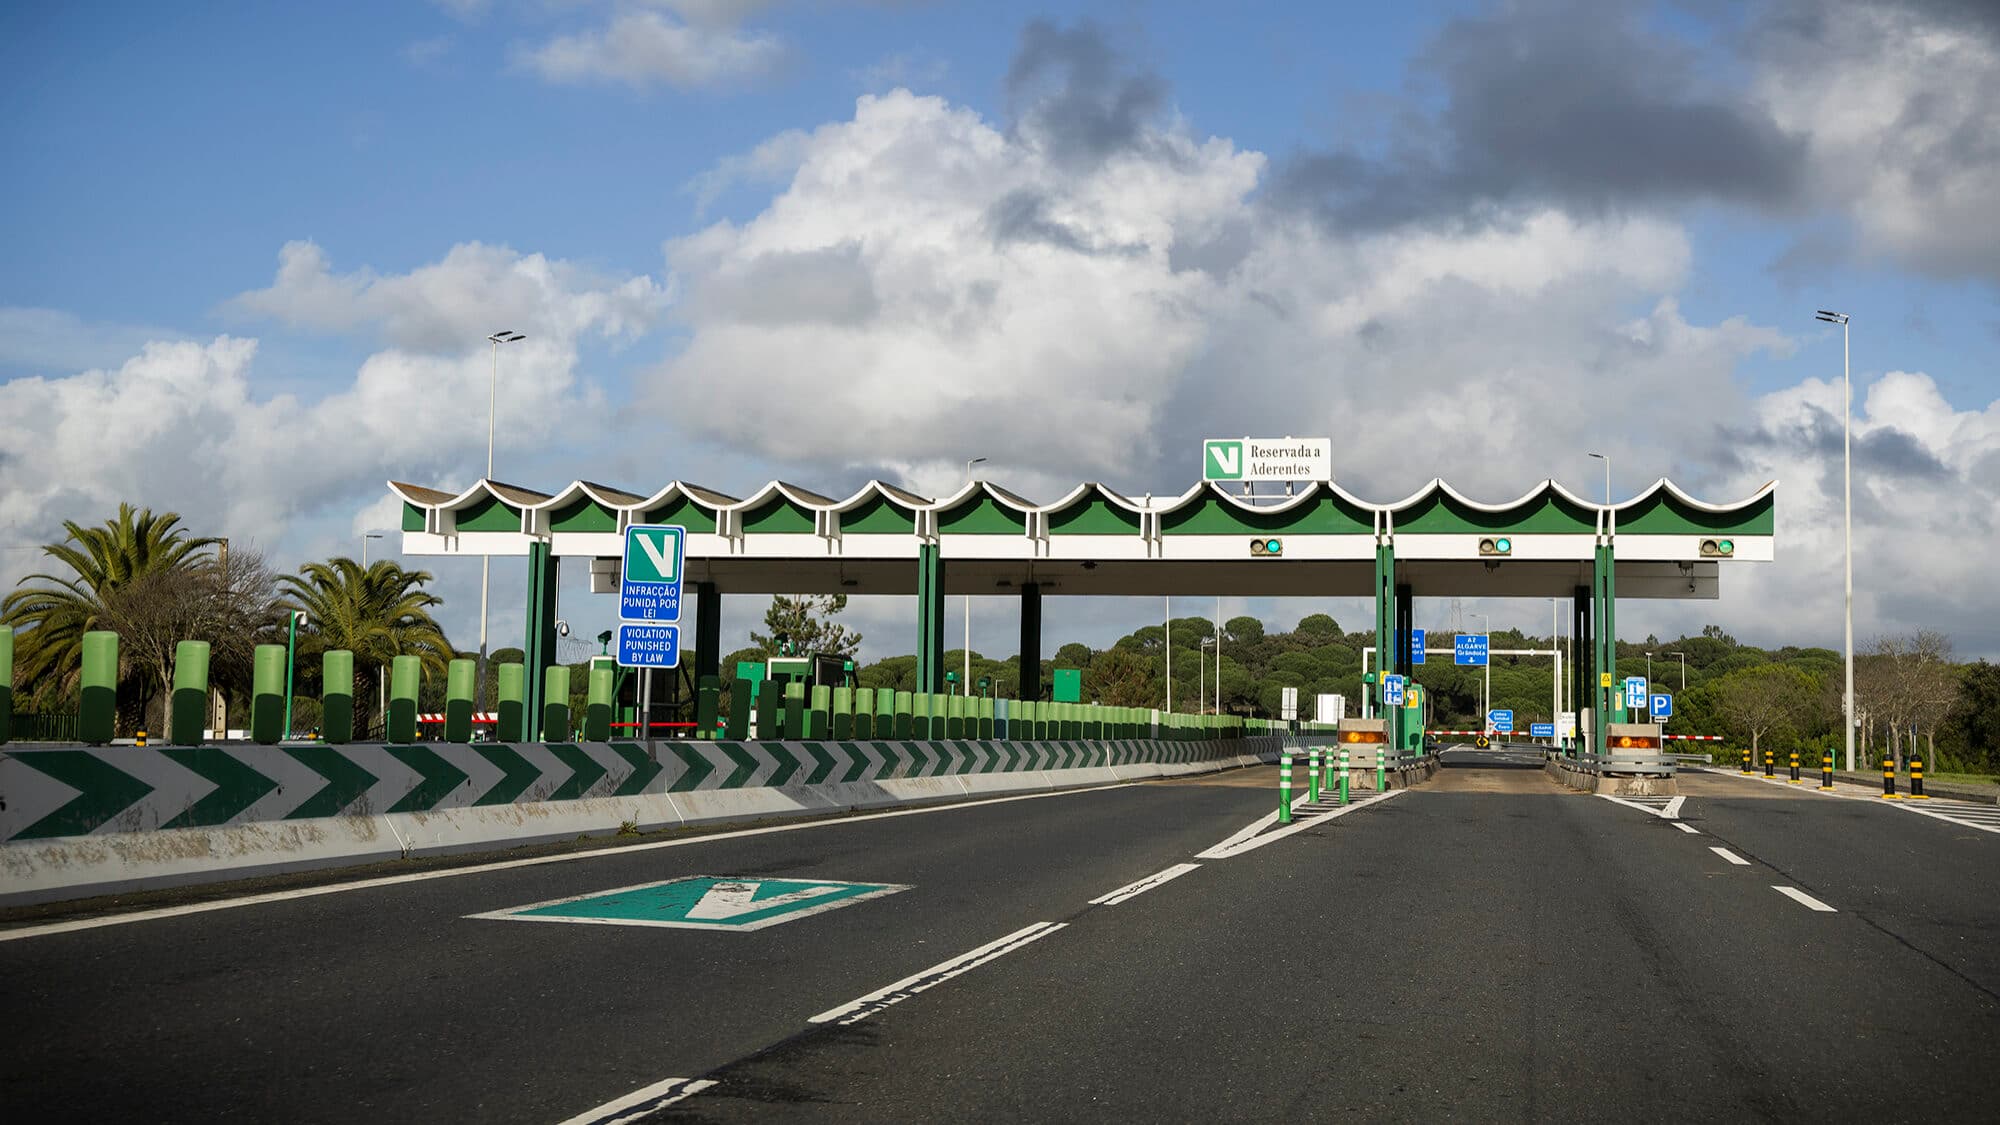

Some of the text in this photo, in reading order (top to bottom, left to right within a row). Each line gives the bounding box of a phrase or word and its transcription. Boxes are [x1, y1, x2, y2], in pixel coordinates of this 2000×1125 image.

[1251, 445, 1321, 458] Reservada a
[1251, 462, 1311, 475] Aderentes
[626, 585, 677, 597] INFRACÇÃO
[623, 598, 677, 609] PUNIDA POR
[643, 609, 656, 618] LEI
[626, 629, 672, 639] VIOLATION
[625, 641, 671, 652] PUNISHED
[631, 653, 664, 664] BY LAW
[1654, 696, 1667, 714] P
